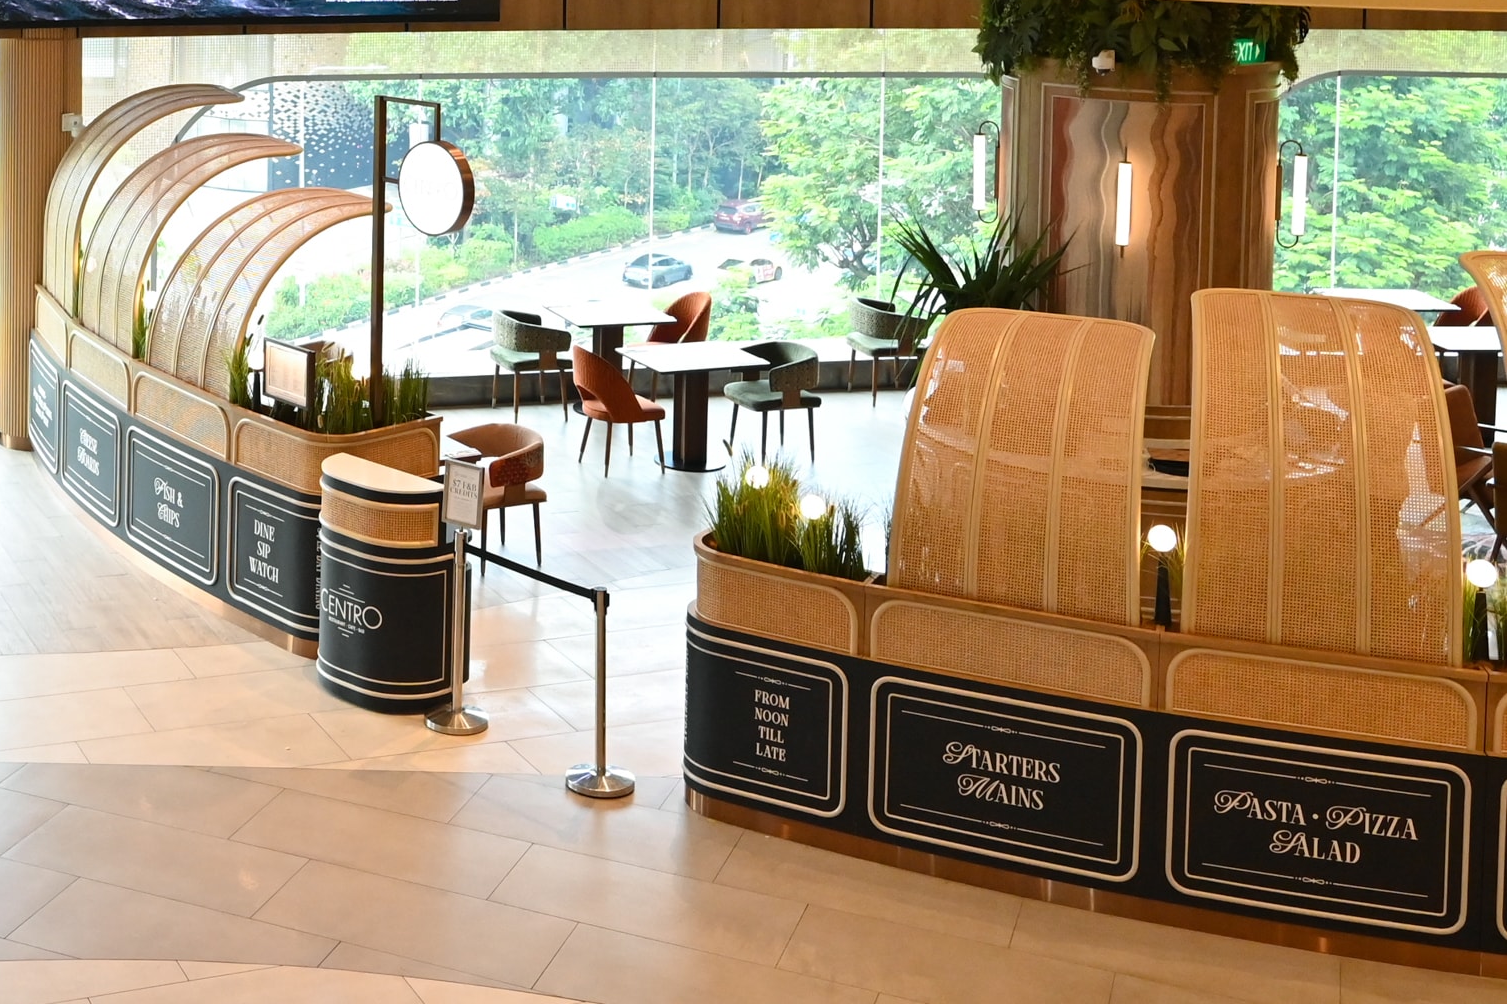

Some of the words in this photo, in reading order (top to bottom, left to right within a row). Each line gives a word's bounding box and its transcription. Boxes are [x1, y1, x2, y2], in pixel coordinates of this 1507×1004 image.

[153, 477, 176, 505] FISH
[177, 491, 184, 508] &
[156, 501, 180, 528] CHIPS
[253, 519, 276, 543] DINE
[256, 541, 271, 559] SIP
[248, 555, 279, 584] WATCH
[320, 588, 383, 630] CENTRO
[754, 689, 790, 710] FROM
[754, 707, 789, 727] NOON
[758, 725, 785, 744] TILL
[755, 742, 787, 762] LATE
[942, 741, 1061, 784] STARTERS
[957, 773, 1044, 811] MAINS
[1213, 789, 1307, 826] PASTA
[1325, 804, 1419, 841] PIZZA
[1269, 829, 1361, 864] SALAD
